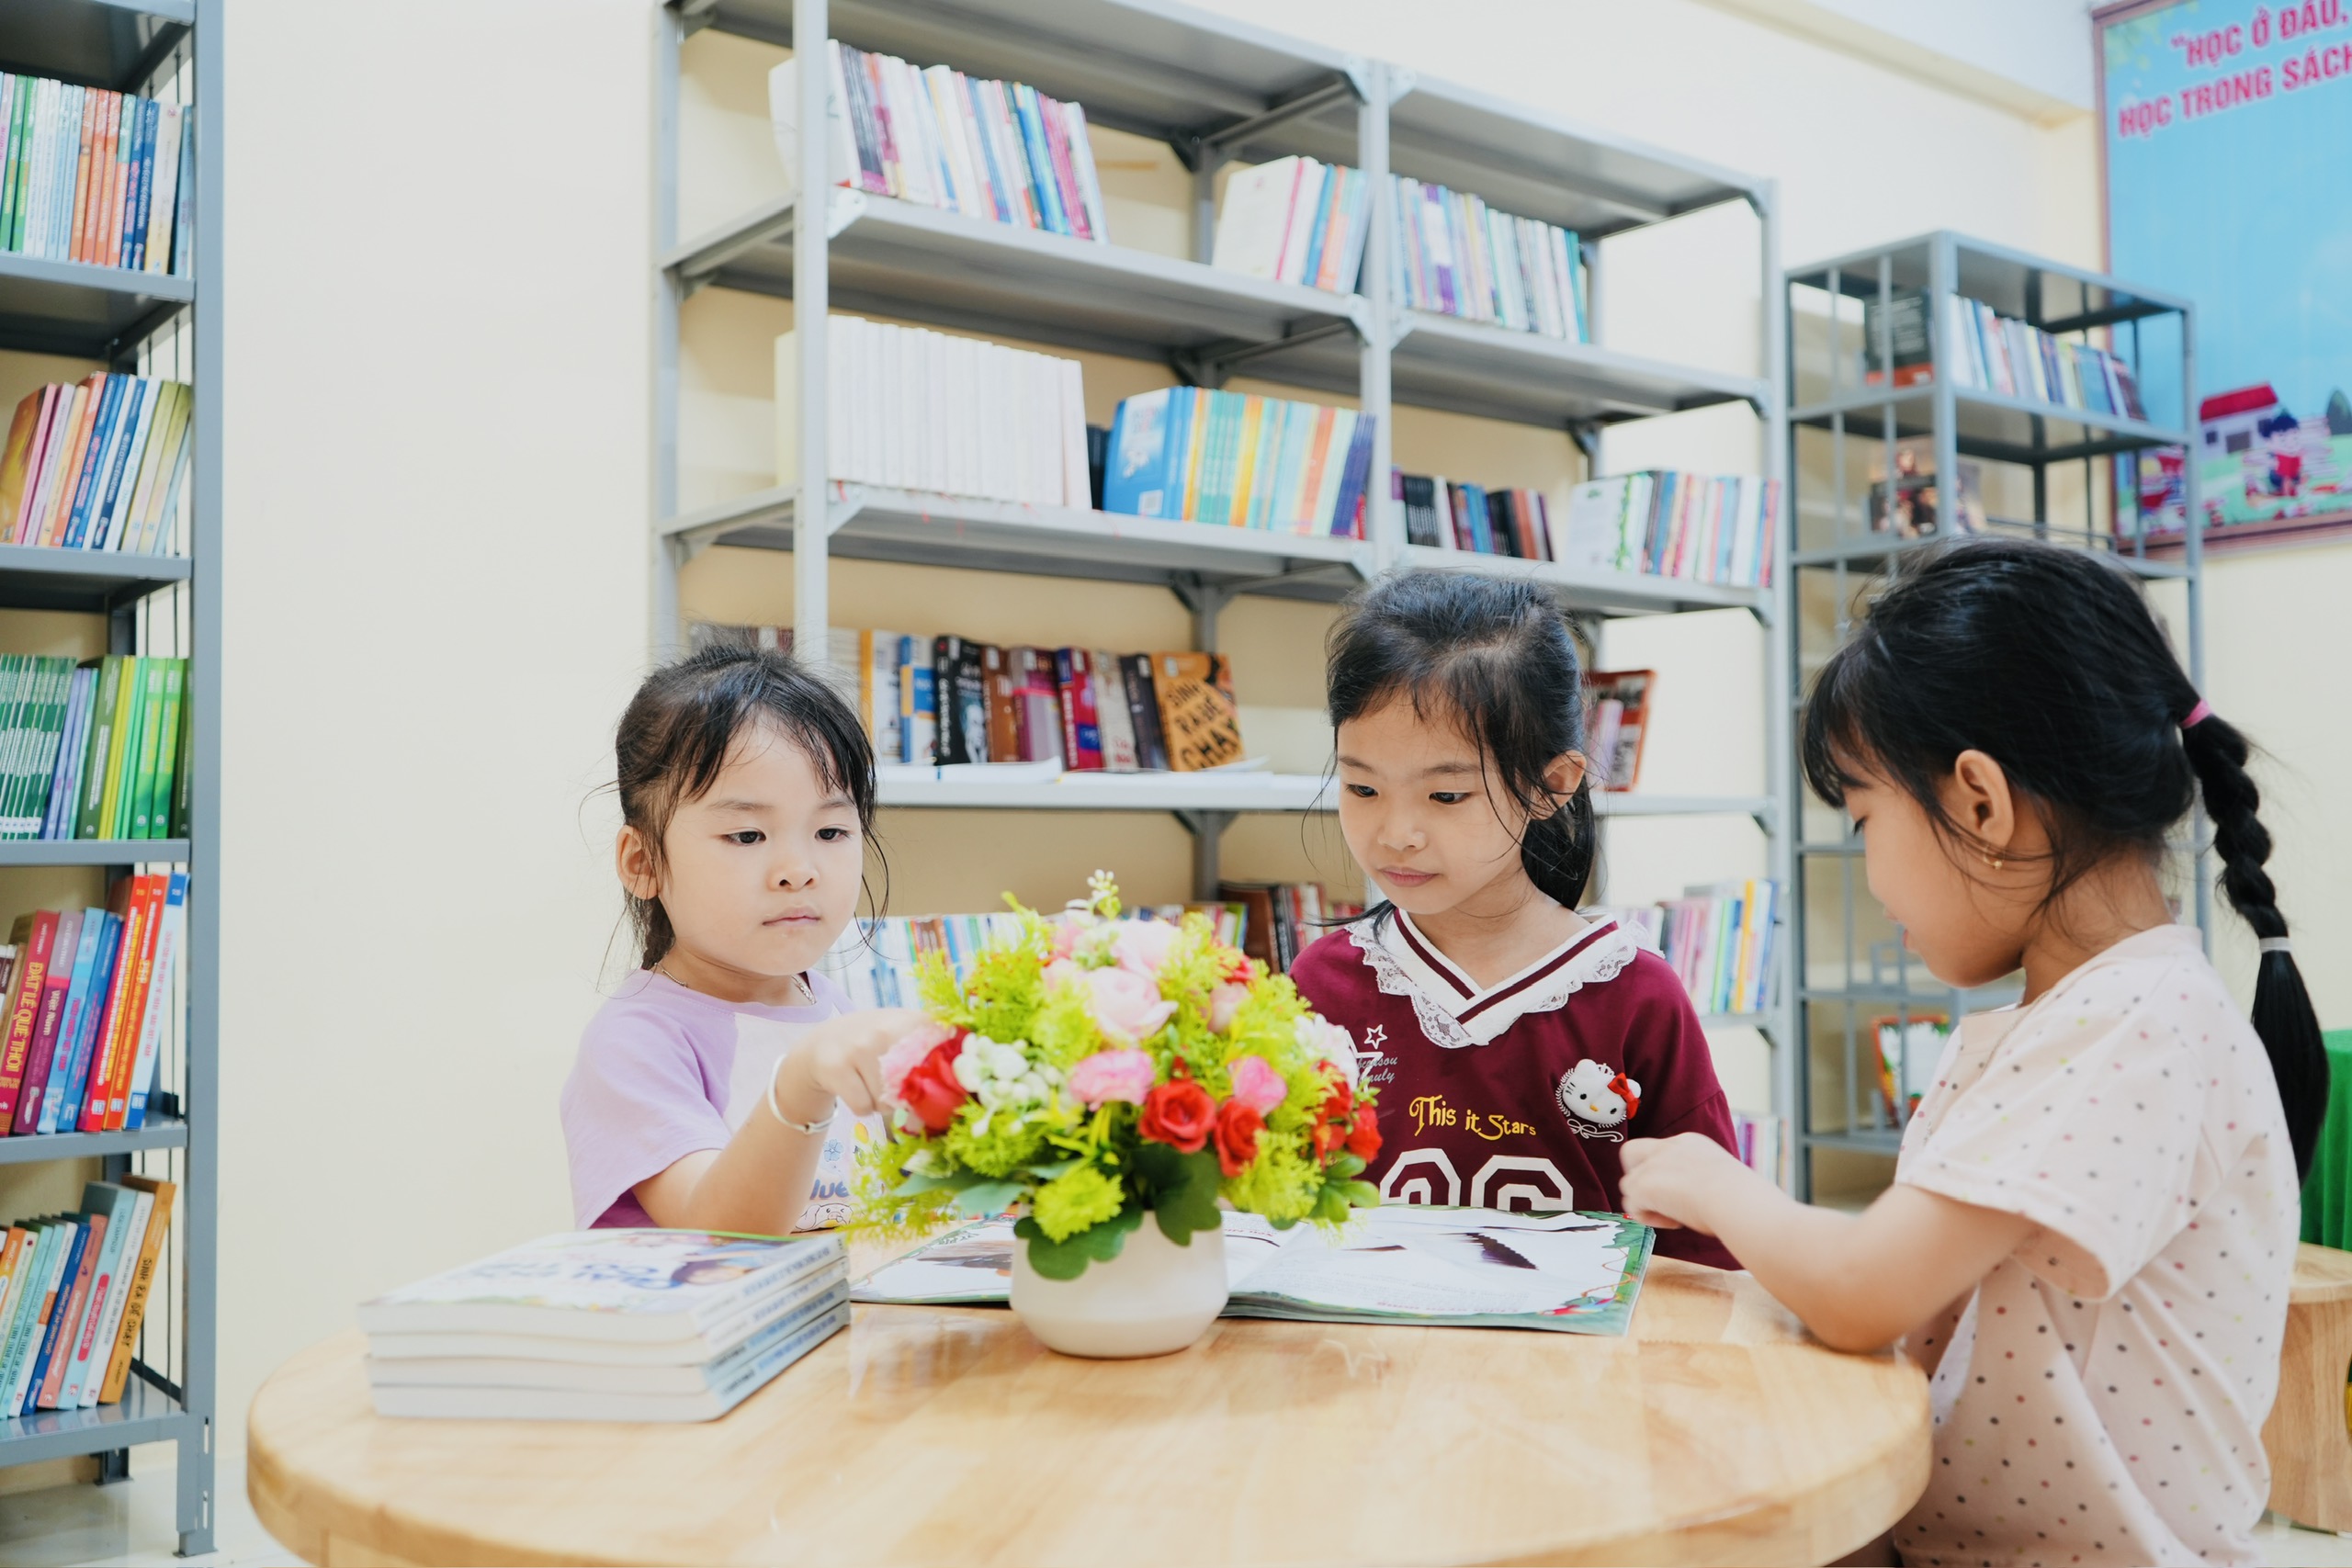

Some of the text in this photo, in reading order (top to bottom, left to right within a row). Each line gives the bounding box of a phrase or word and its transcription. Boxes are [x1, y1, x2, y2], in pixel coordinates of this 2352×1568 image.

[2119, 96, 2171, 138] HỌC
[2180, 66, 2273, 118] TRONG
[1408, 1094, 1537, 1141] This it Stars
